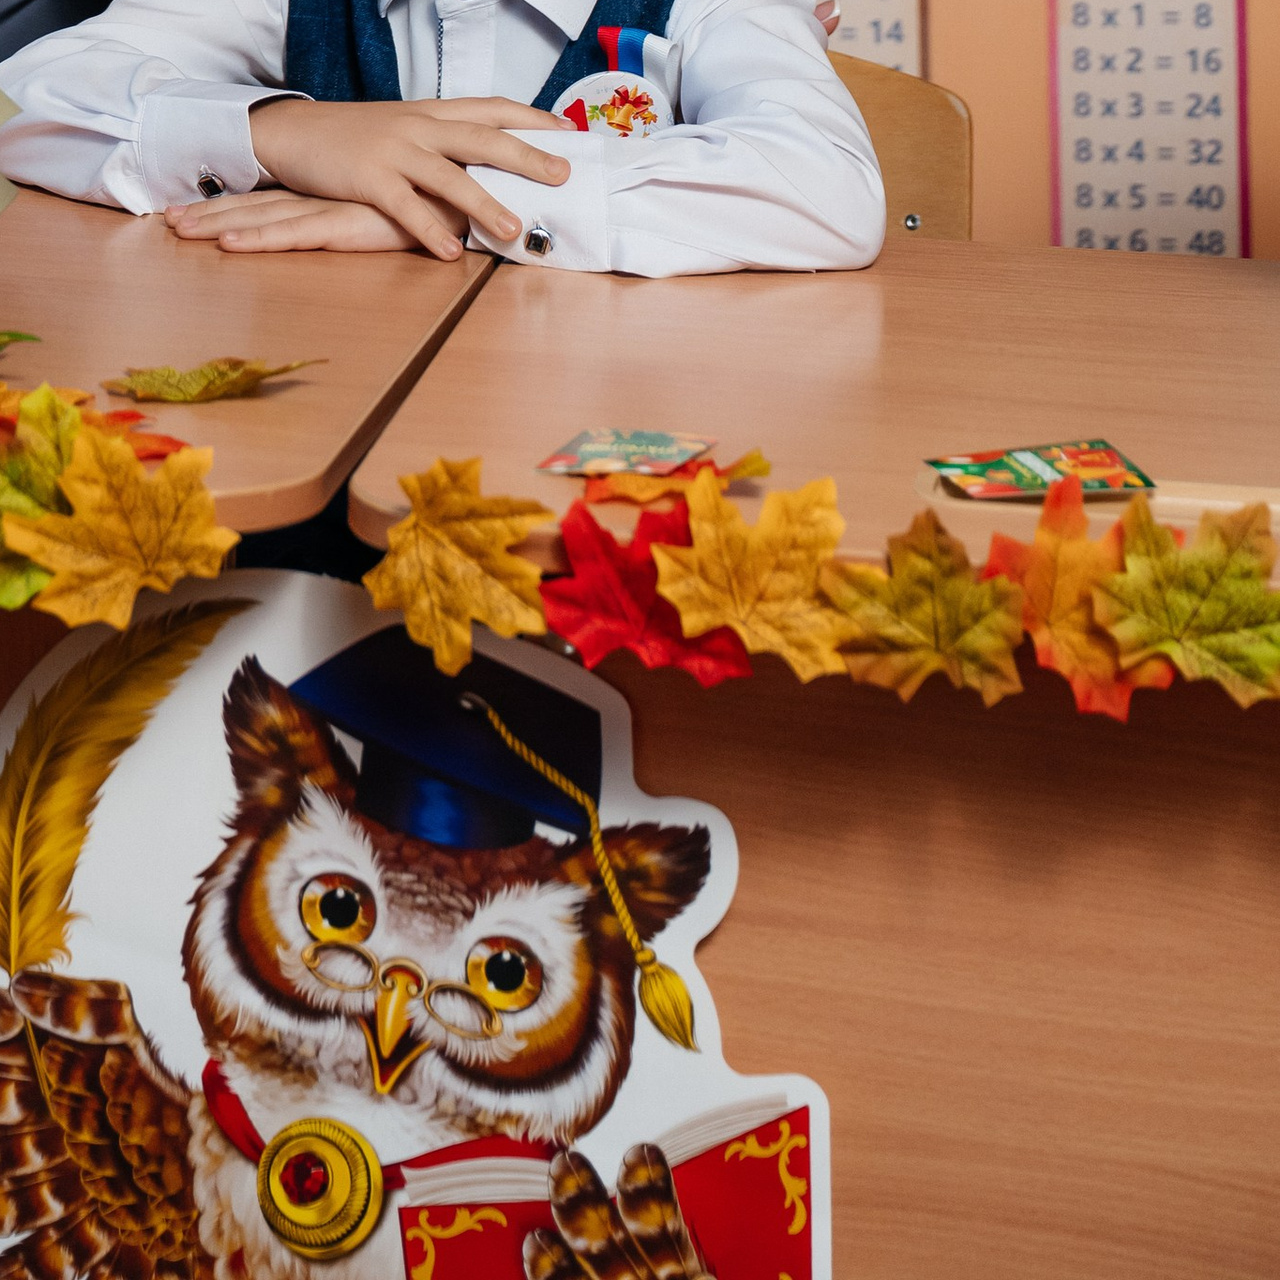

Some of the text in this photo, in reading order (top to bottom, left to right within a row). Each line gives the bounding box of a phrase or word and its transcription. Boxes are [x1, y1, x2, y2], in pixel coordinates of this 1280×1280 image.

[1072, 2, 1090, 28] 8
[1132, 2, 1143, 27] 1
[1195, 2, 1213, 28] 8
[870, 20, 904, 43] 14
[1073, 47, 1090, 72] 8
[1126, 47, 1143, 73] 2
[1187, 47, 1222, 74] 16
[1074, 92, 1091, 117] 8
[1128, 92, 1143, 118] 3
[1186, 92, 1222, 118] 24
[1075, 137, 1092, 162] 8
[1127, 139, 1145, 162] 4
[1189, 138, 1223, 165] 32
[1076, 183, 1093, 209] 8
[1129, 183, 1146, 209] 5
[1187, 185, 1225, 210] 40
[1130, 228, 1147, 252] 6
[1189, 230, 1225, 255] 48
